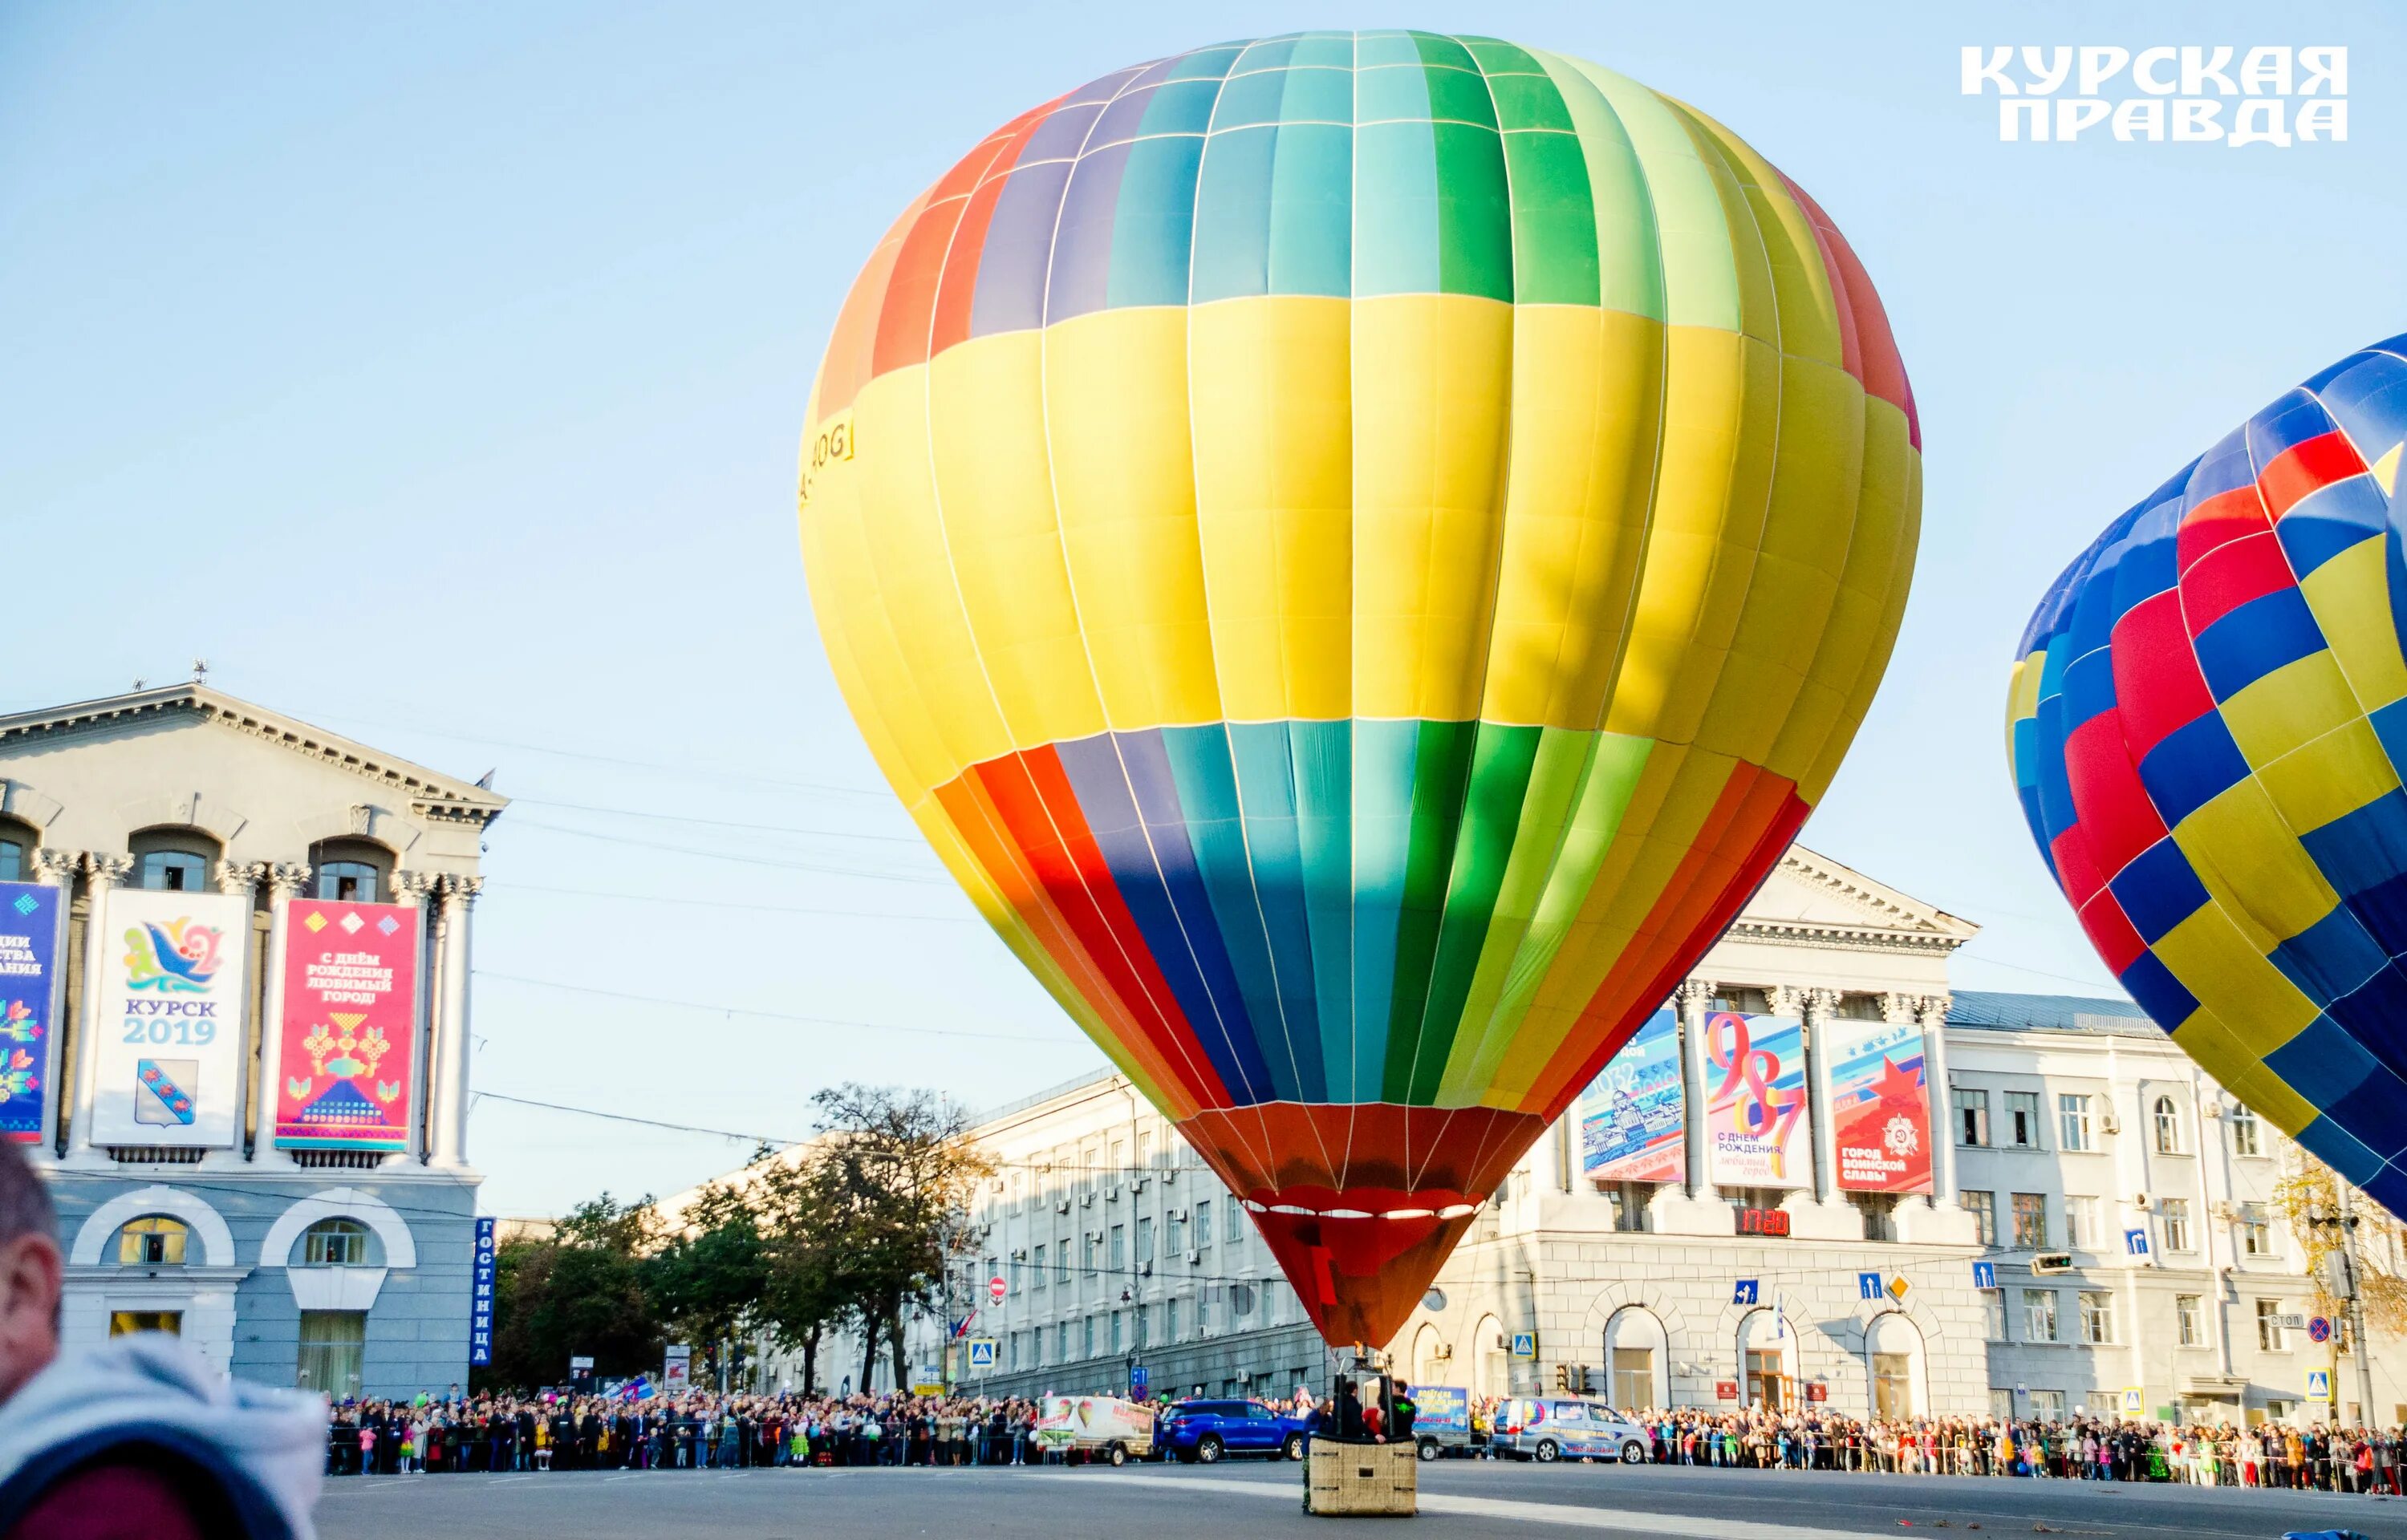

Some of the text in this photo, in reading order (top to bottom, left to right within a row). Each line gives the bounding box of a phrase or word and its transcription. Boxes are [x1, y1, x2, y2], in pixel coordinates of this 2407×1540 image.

[322, 951, 380, 966] С ДНЁМ
[307, 964, 393, 979] РОЖДЕНИЯ
[307, 977, 392, 992] ЛЮБИМЫЙ
[322, 991, 375, 1005] ГОРОД!
[125, 999, 217, 1017] КУРСК
[123, 1018, 217, 1045] 2019
[1718, 1132, 1726, 1141] С
[1719, 1142, 1783, 1155] РОЖДЕНИЯ,
[1842, 1147, 1881, 1161] ГОРОД
[1842, 1158, 1907, 1172] ВОИНСКОЙ
[1842, 1169, 1888, 1182] СЛАВЫ
[473, 1220, 493, 1360] ГОСТИНИЦА
[2271, 1315, 2299, 1326] СТОП
